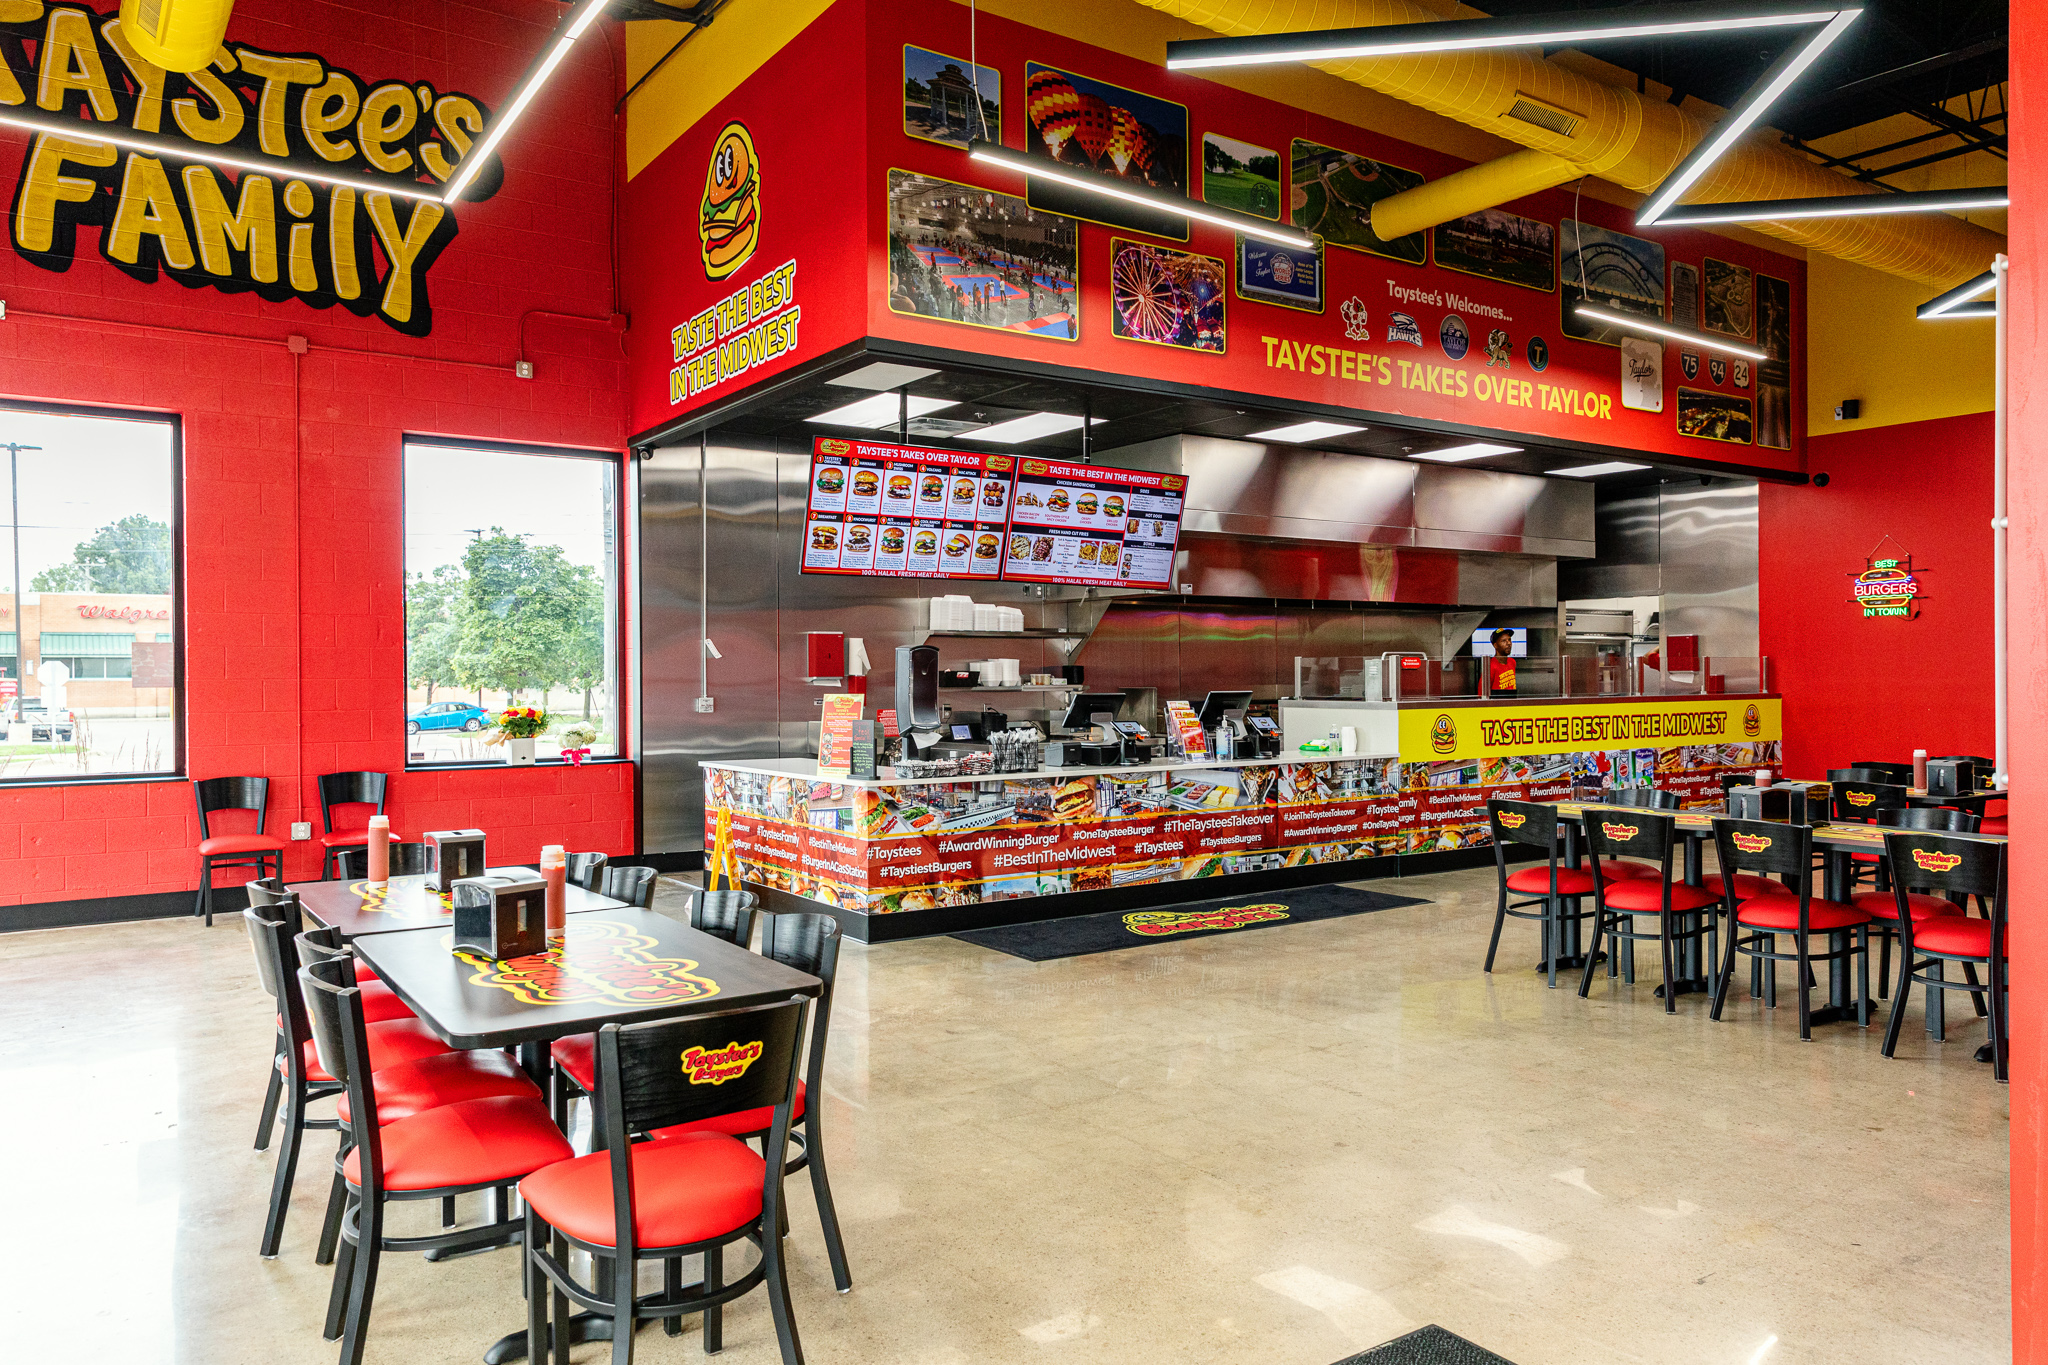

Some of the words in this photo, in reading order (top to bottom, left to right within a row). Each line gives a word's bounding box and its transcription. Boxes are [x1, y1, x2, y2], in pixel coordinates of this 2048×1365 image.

[672, 307, 715, 361] TASTE
[716, 288, 748, 337] THE
[751, 260, 795, 321] BEST
[1387, 279, 1442, 307] Taystee's
[1445, 292, 1513, 322] Welcomes...
[1388, 327, 1422, 347] HAWKS
[671, 362, 686, 404] IN
[688, 349, 717, 393] THE
[719, 307, 799, 378] MIDWEST
[1683, 356, 1697, 373] 75
[1261, 335, 1392, 386] TAYSTEE'S
[1398, 359, 1468, 398] TAKES
[1474, 373, 1532, 408] OVER
[1537, 384, 1612, 420] TAYLOR
[1629, 359, 1654, 381] Taylor
[1711, 361, 1724, 378] 94
[1735, 365, 1747, 381] 24
[856, 445, 898, 459] TAYSTEE'S
[899, 449, 925, 461] TAKES
[926, 452, 949, 463] OVER
[950, 454, 980, 466] TAYLOR
[1049, 466, 1071, 475] TASTE
[1072, 468, 1086, 477] THE
[1087, 470, 1104, 479] BEST
[1105, 472, 1113, 480] IN
[1114, 473, 1128, 482] THE
[1129, 475, 1160, 486] MIDWEST
[1874, 559, 1898, 568] BEST
[1855, 583, 1917, 596] BURGERS
[1864, 608, 1875, 617] IN
[1876, 607, 1908, 616] TOWN
[1482, 719, 1534, 746] TASTE
[1536, 718, 1568, 743] THE
[1571, 716, 1611, 741] BEST
[1613, 715, 1630, 739] IN
[1632, 714, 1661, 738] THE
[1663, 712, 1727, 736] MIDWEST
[1669, 775, 1711, 784] #OneTaysteeBurger
[1429, 793, 1483, 805] #BestInTheMidwest
[1491, 790, 1522, 800] #Taystees
[1284, 808, 1356, 821] #JoinTheTaysteeTakeover
[866, 845, 922, 861] #Taystees
[938, 834, 1060, 854] #AwardWinningBurger
[1073, 825, 1156, 841] #OneTaysteeBurger
[1164, 814, 1275, 834] #TheTaysteesTakeover
[1284, 823, 1358, 838] #AwardWinningBurger
[757, 825, 799, 848] #TaysteesFamily
[808, 836, 857, 857] #BestInTheMidwest
[754, 842, 798, 862] #OneTaysteeBurger
[801, 853, 867, 880] #BurgerInAGasStation
[880, 860, 972, 878] #TaystiestBurgers
[993, 844, 1116, 868] #BestInTheMidwest
[1134, 840, 1184, 855] #Taystees
[1200, 833, 1262, 847] #TaysteesBurgers
[1913, 849, 1960, 864] Taystee's
[1920, 861, 1948, 870] Burgers
[1135, 912, 1282, 934] Burgers
[685, 1044, 760, 1070] Taystee's
[694, 1065, 743, 1081] Burgers
